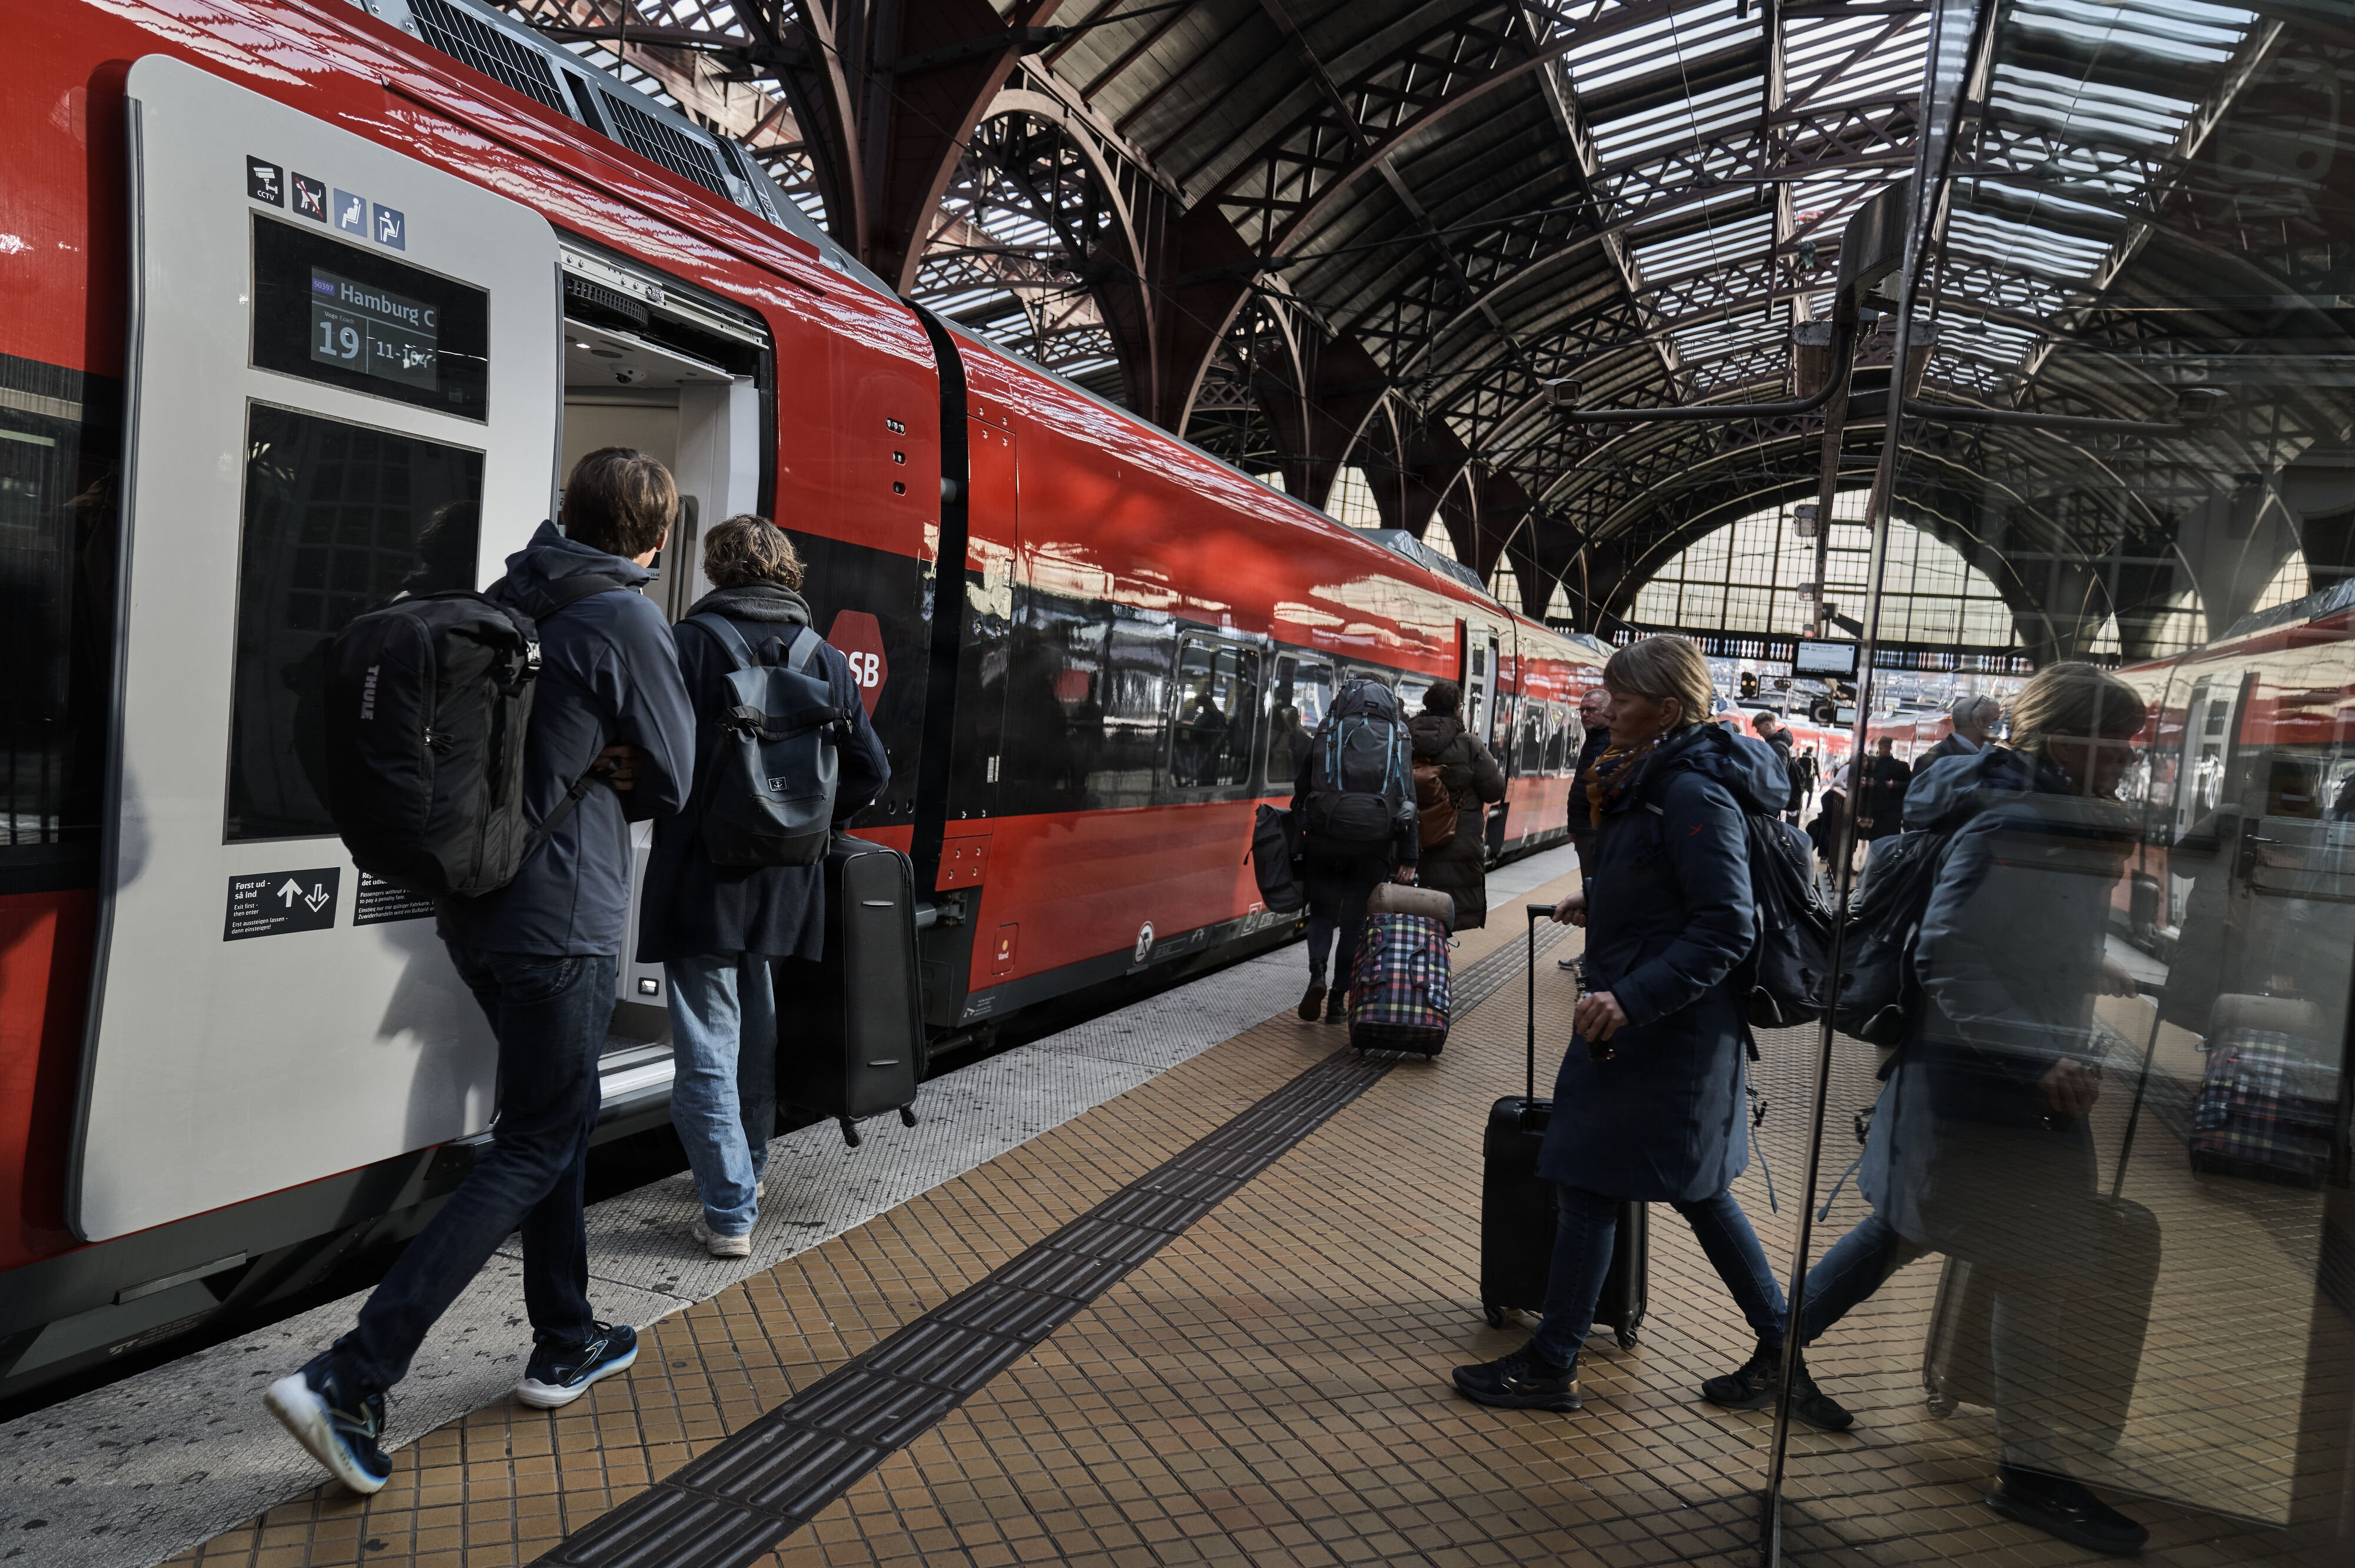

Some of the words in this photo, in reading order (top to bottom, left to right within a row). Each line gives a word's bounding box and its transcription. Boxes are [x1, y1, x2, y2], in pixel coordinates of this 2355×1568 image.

[257, 190, 275, 201] CCTV
[314, 281, 334, 293] 50397
[340, 282, 419, 327] Hamburg
[324, 311, 338, 320] Vogn
[340, 315, 354, 325] Coach
[319, 321, 359, 360] 19
[838, 650, 880, 687] SB
[360, 665, 380, 720] THULE
[1815, 705, 1829, 722] C
[235, 891, 244, 900] så
[245, 890, 257, 898] ind
[358, 911, 393, 920] Zuwiderhandeln
[998, 951, 1009, 961] Vand
